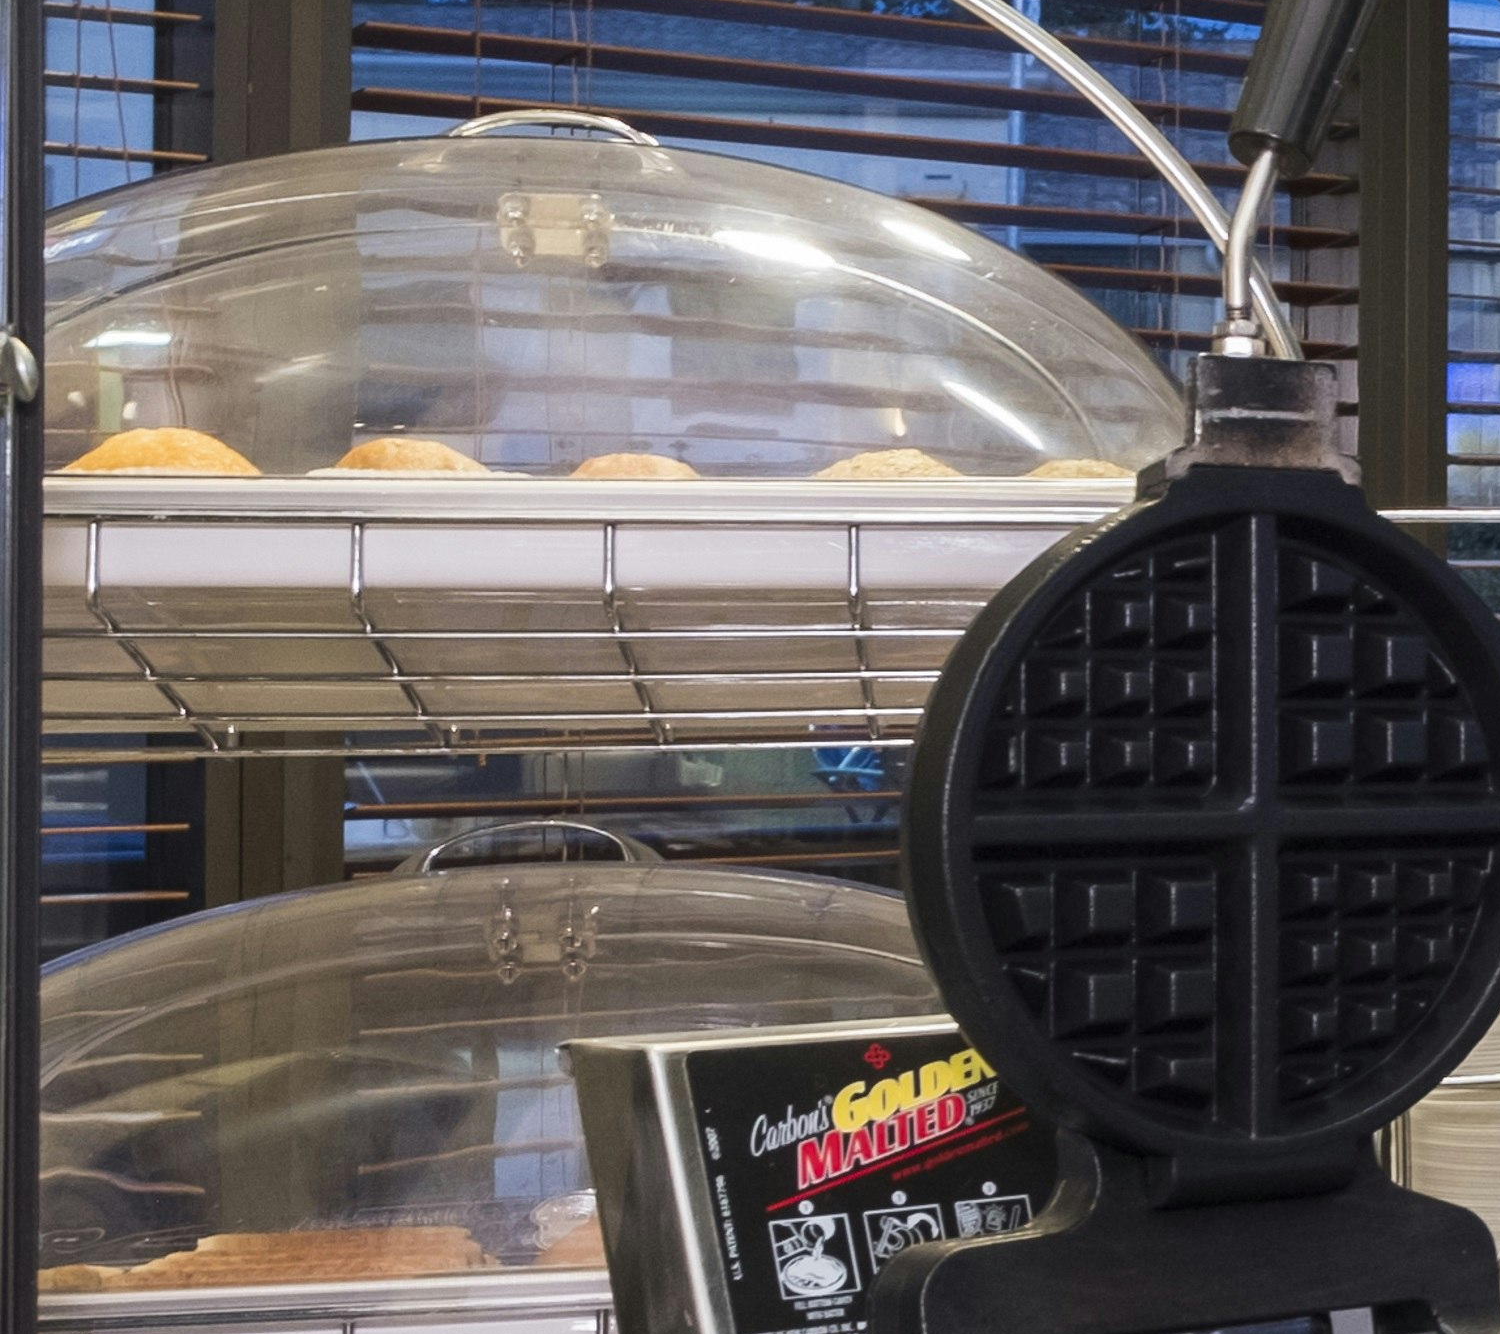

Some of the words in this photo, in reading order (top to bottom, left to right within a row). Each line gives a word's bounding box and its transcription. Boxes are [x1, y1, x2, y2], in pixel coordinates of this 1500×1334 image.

[966, 1081, 999, 1105] SINCE
[969, 1095, 996, 1117] 1937
[751, 1099, 829, 1157] Carbon's
[797, 1093, 967, 1190] MALTED
